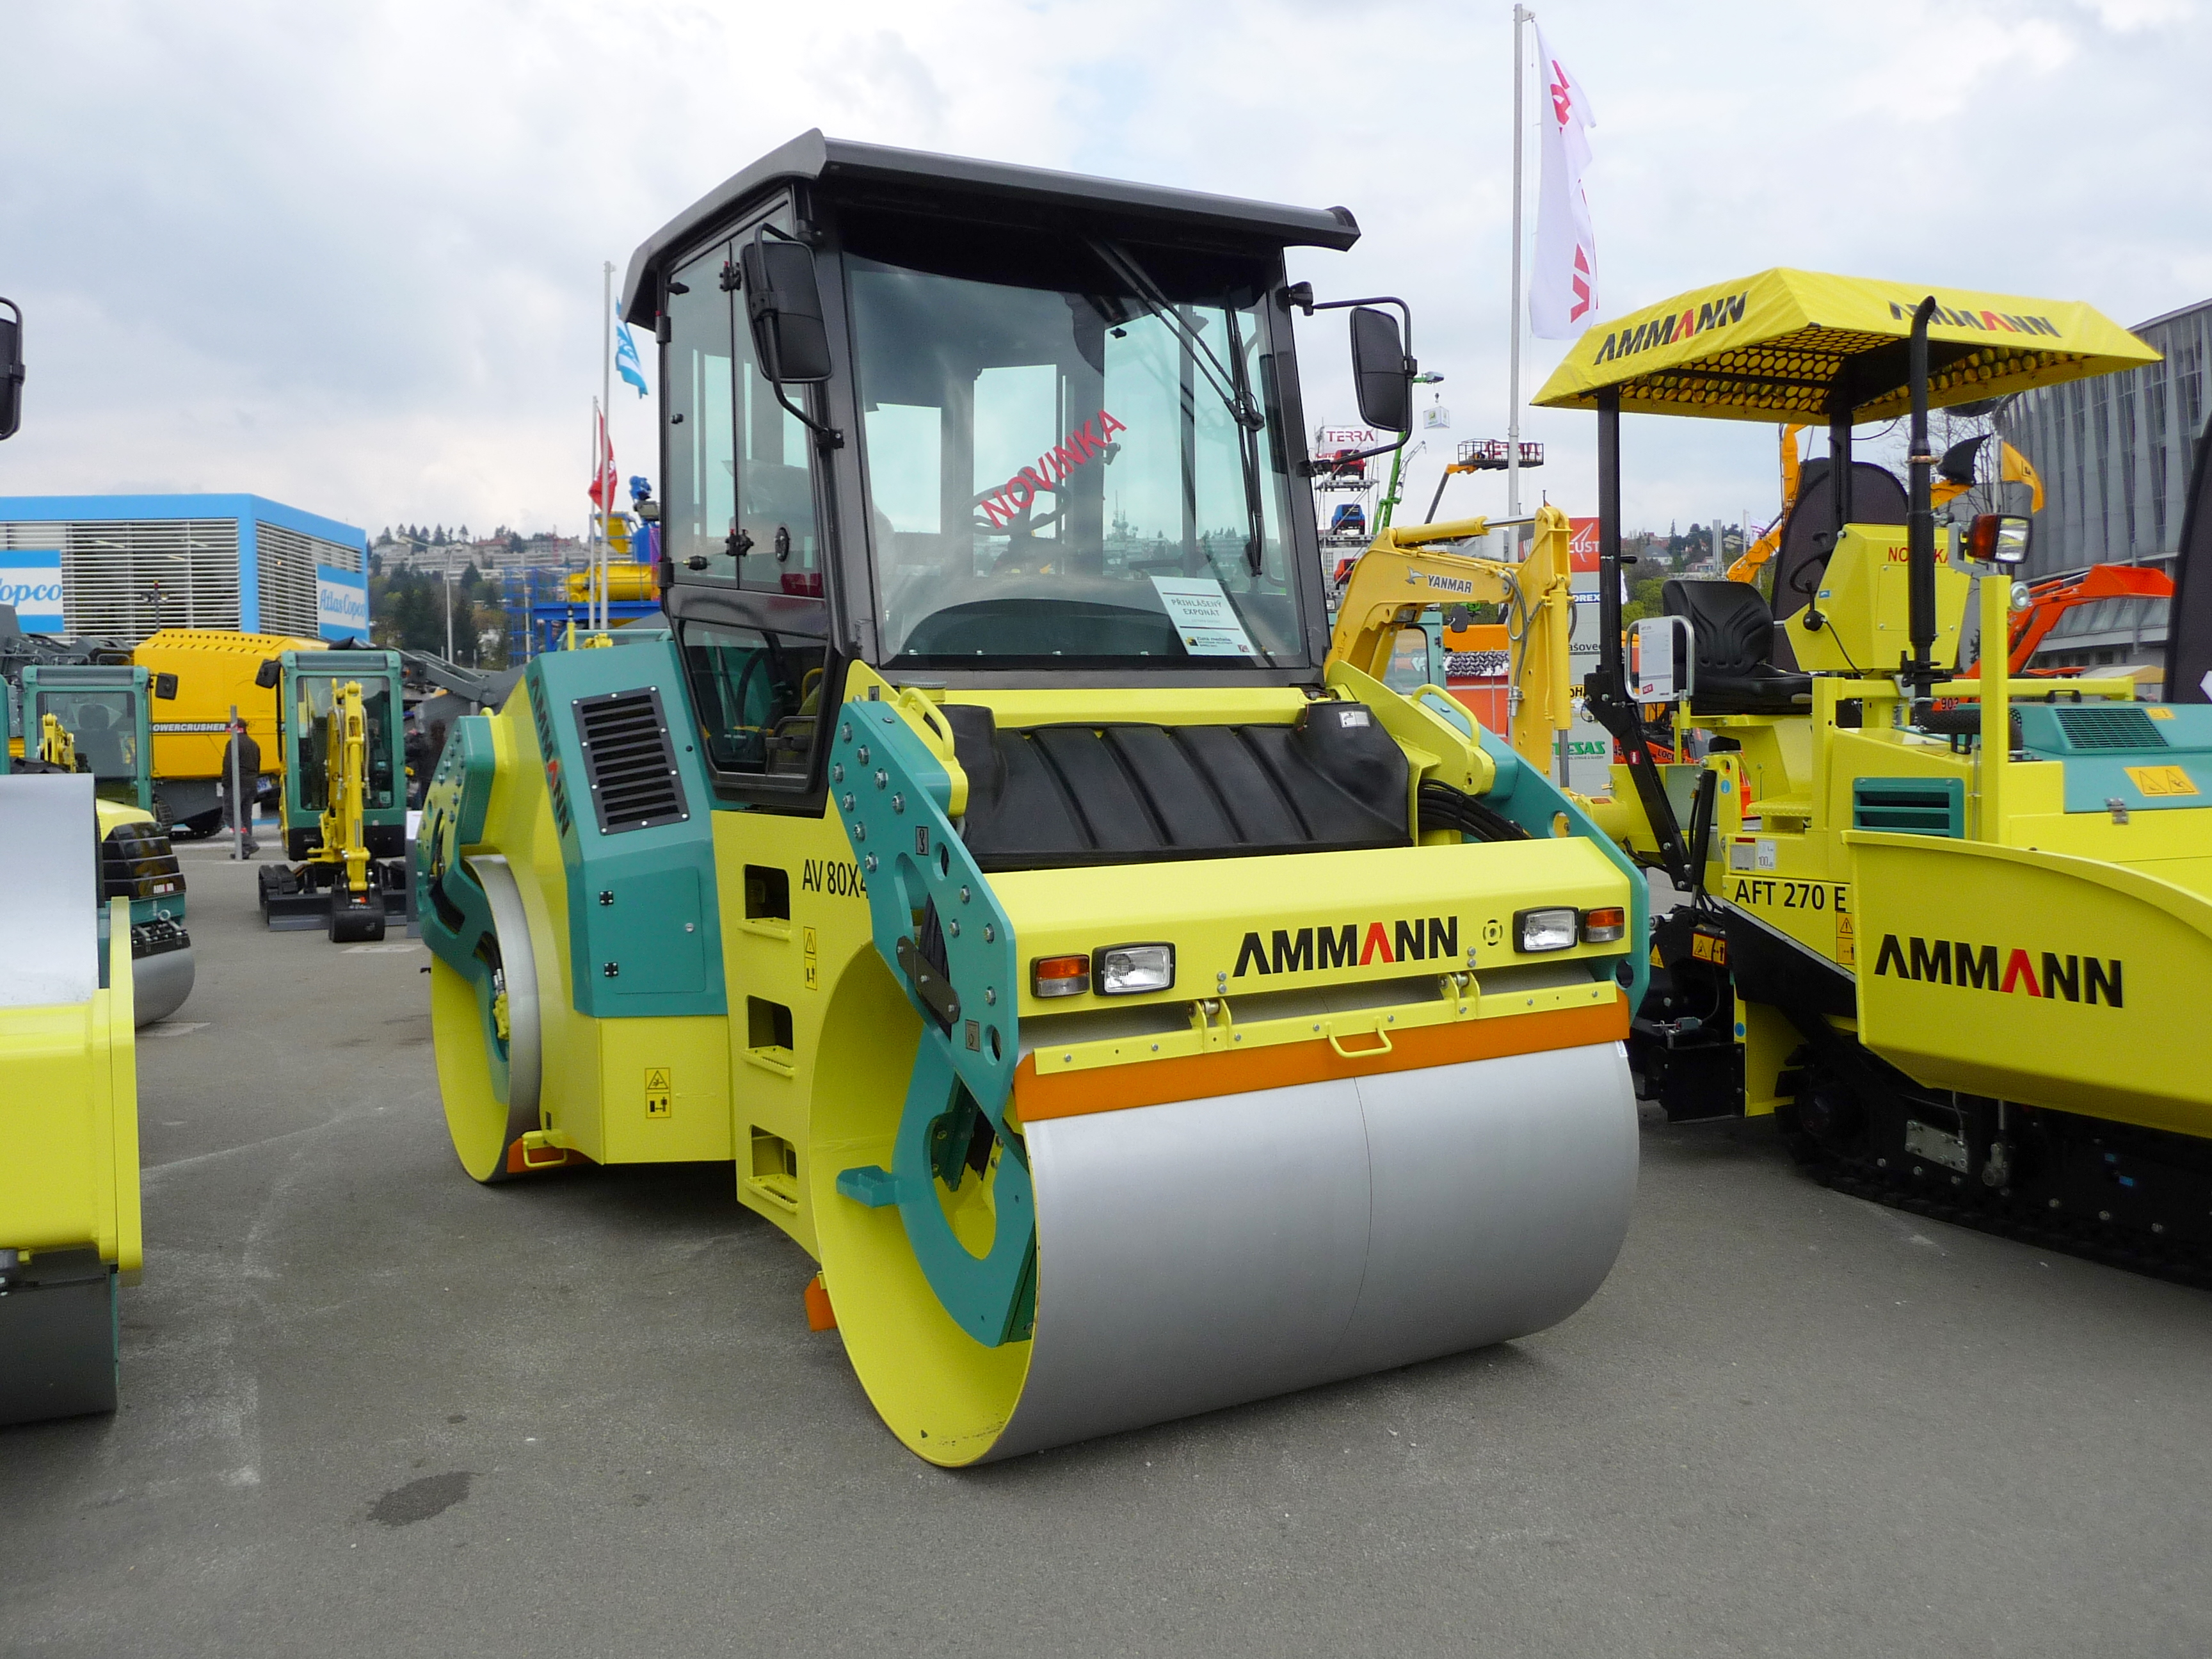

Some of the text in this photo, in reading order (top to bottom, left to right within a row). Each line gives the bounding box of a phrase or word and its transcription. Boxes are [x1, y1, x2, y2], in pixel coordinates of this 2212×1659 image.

[1593, 290, 1749, 365] AMMANN
[1326, 430, 1374, 442] TERRA
[981, 408, 1127, 529] NOVINKA
[1569, 541, 1599, 553] CUST
[0, 578, 63, 607] opco
[1428, 574, 1472, 594] YANMAR
[319, 589, 342, 613] Atlas
[1568, 643, 1601, 652] ašove
[152, 723, 226, 732] OWERCRUSHER
[1657, 748, 1686, 764] LOCUT
[802, 858, 823, 892] AV
[1735, 879, 1846, 911] AFT 270 E
[1232, 915, 1458, 978] AMMANN
[1873, 933, 2124, 1008] AMMANN
